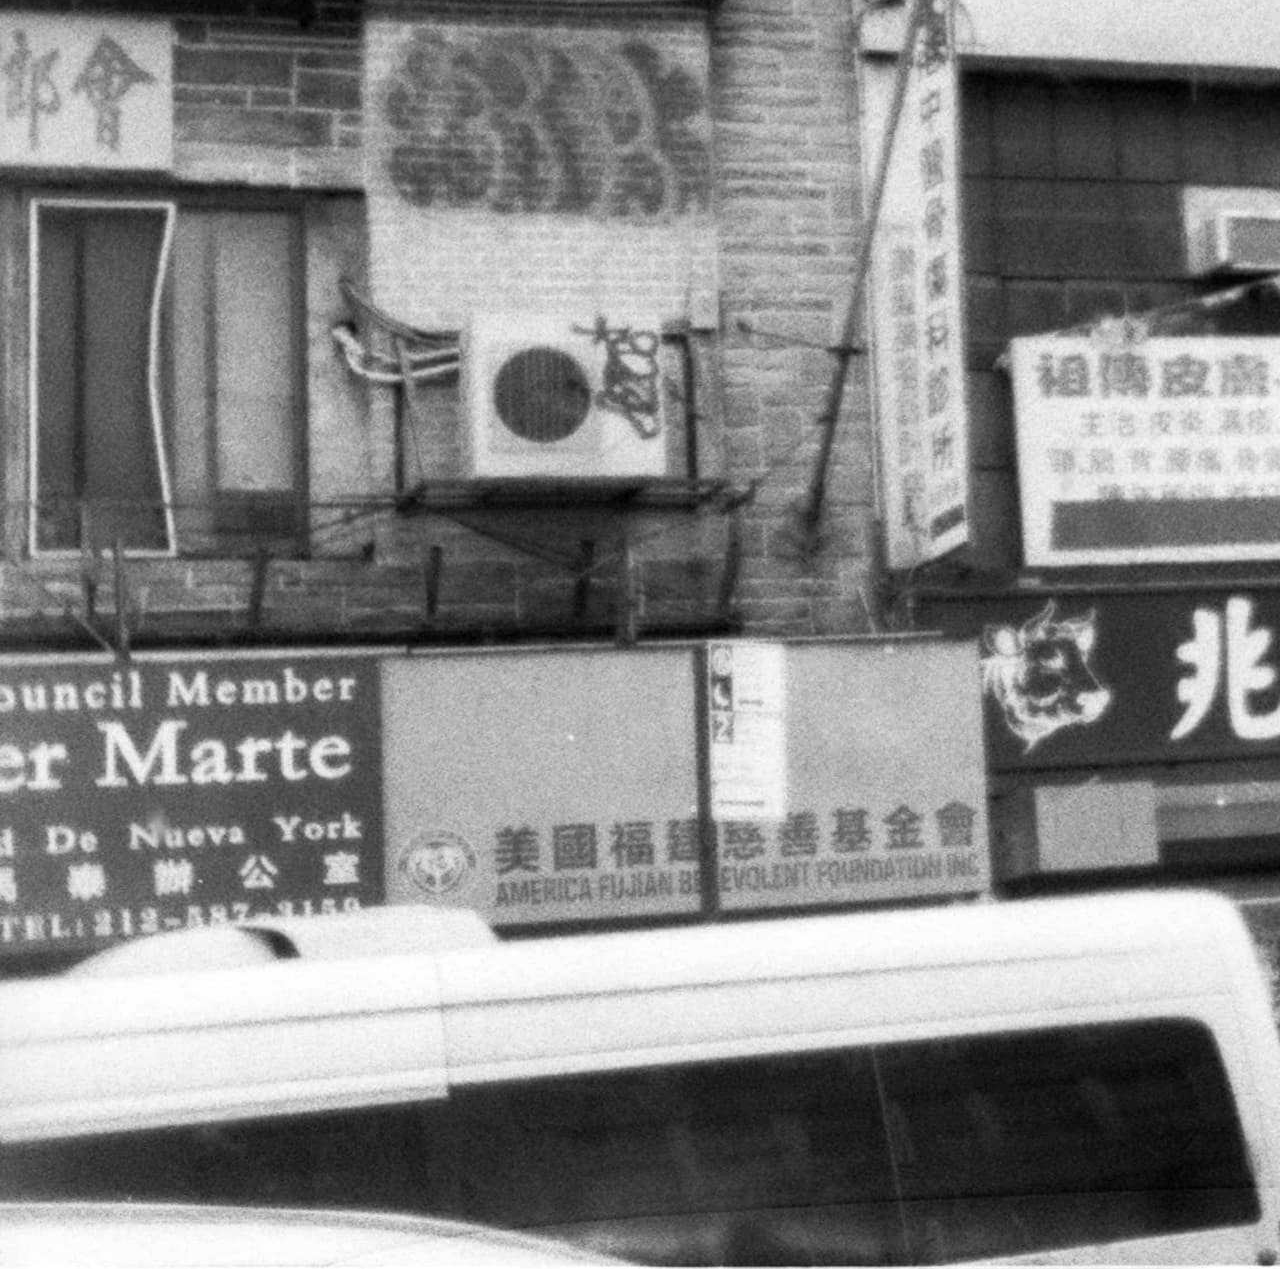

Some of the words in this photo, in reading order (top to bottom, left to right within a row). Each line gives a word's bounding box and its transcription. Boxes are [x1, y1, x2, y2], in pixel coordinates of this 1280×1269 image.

[166, 668, 357, 708] Member
[96, 719, 353, 789] Marte
[46, 825, 99, 855] De
[129, 822, 246, 851] Nueva
[273, 812, 362, 843] York
[494, 874, 594, 909] AMERICA
[600, 869, 675, 902] FUJIAN
